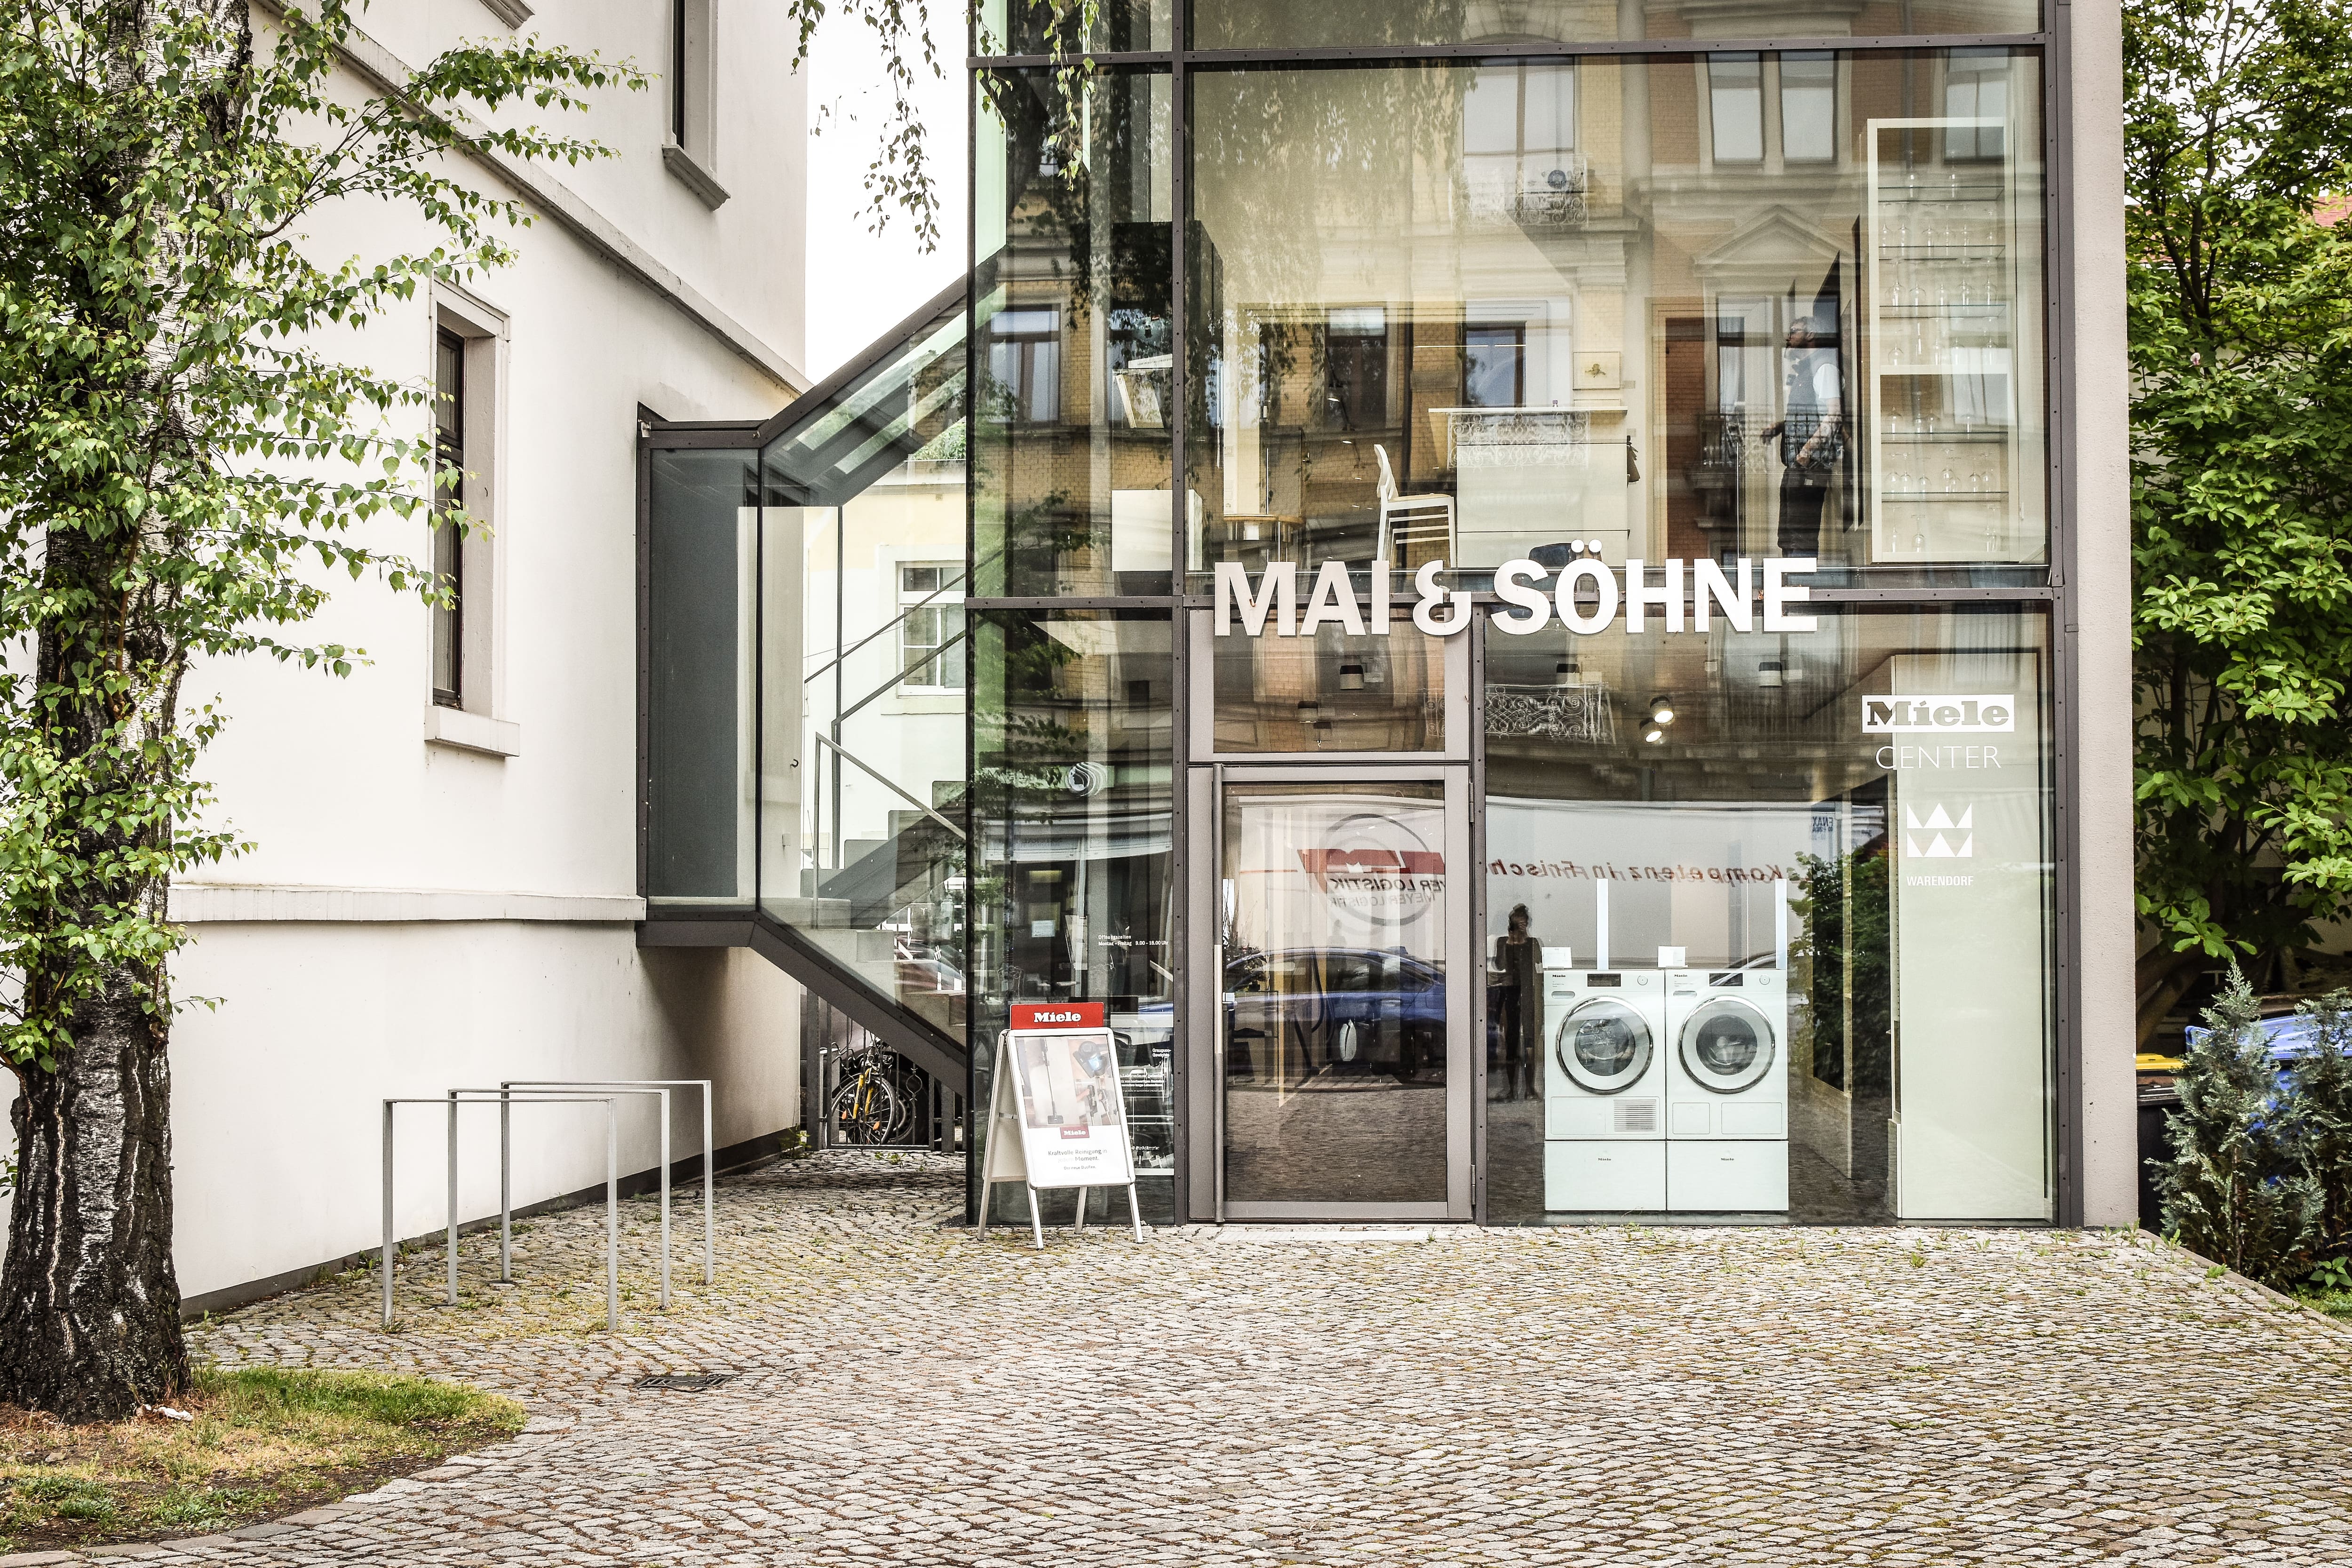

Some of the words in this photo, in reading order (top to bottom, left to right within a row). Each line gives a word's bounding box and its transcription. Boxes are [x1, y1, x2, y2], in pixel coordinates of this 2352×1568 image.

[1214, 560, 1390, 637] MAI
[1413, 560, 1472, 636] &
[1490, 539, 1818, 635] SÖHNE
[1867, 700, 2009, 726] Miele
[1875, 746, 2002, 769] CENTER
[1907, 876, 1974, 886] WARENDORF
[1034, 1012, 1081, 1023] Miele
